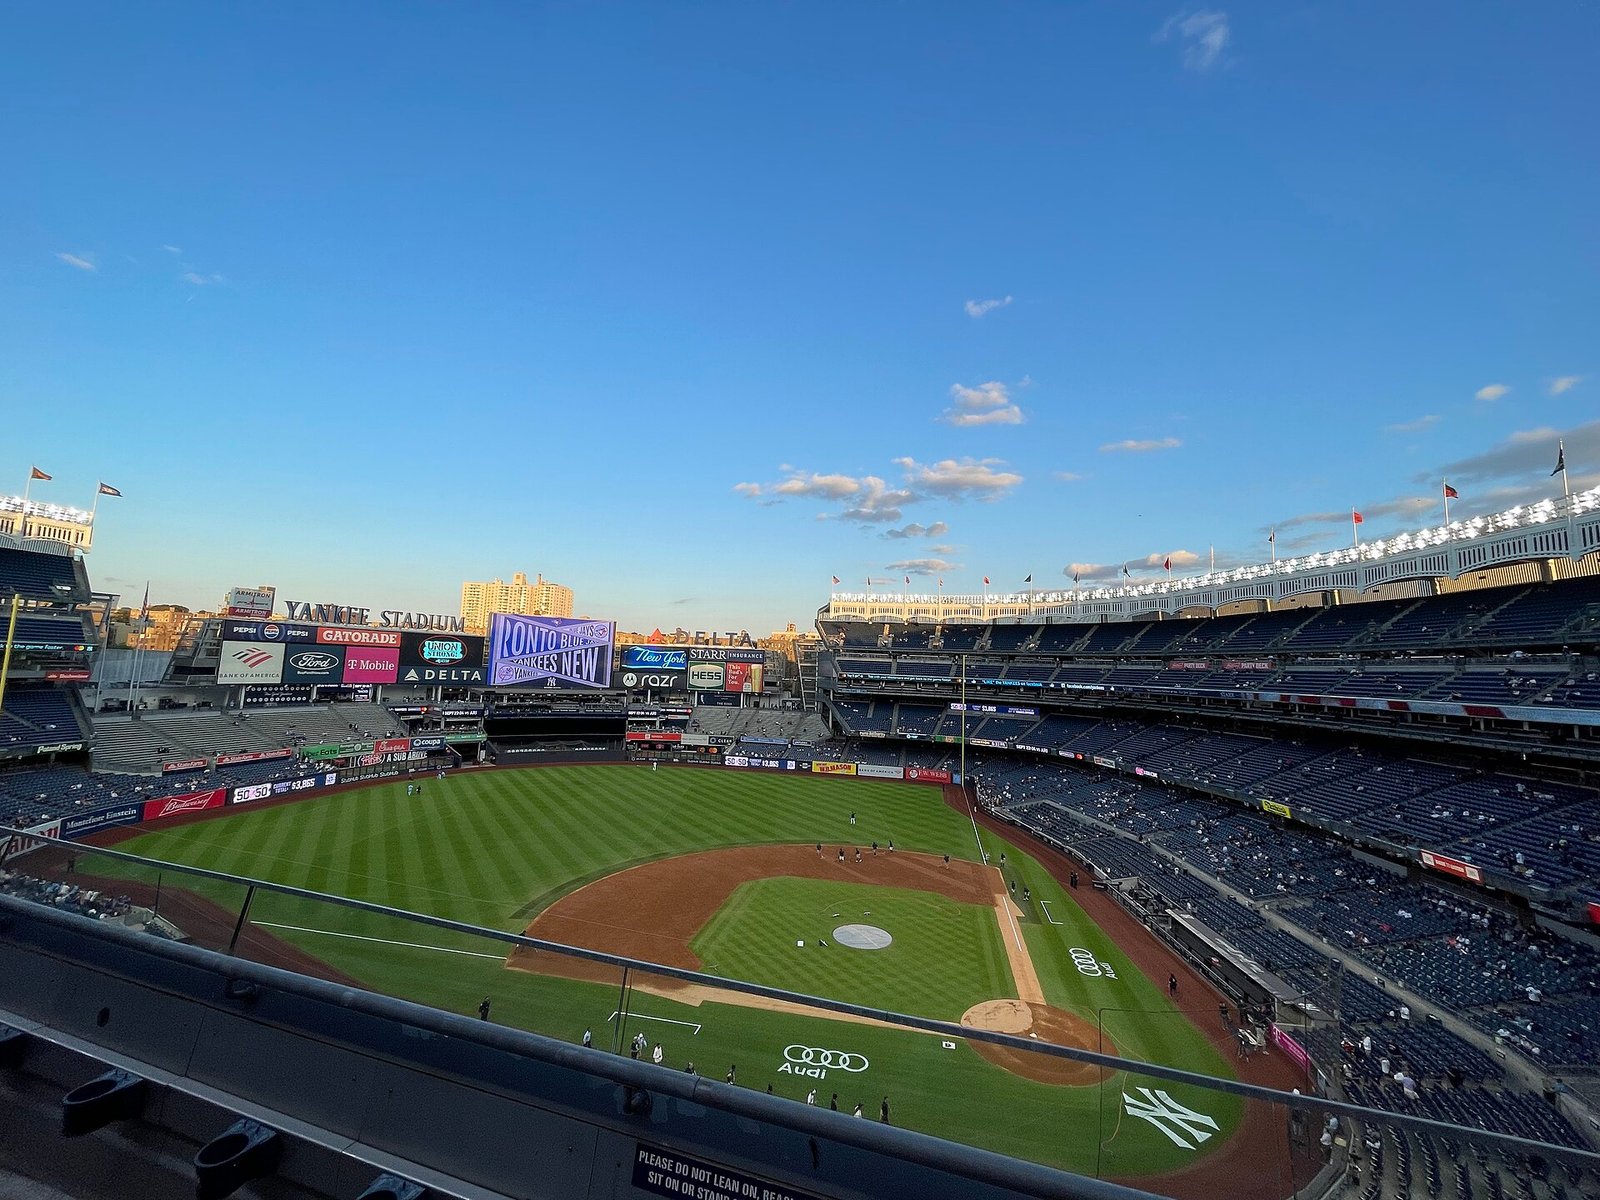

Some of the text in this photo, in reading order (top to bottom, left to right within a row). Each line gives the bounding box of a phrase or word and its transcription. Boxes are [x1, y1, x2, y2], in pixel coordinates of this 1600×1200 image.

[236, 590, 271, 598] ARMITRON
[284, 600, 466, 633] YANKEE STADIUM
[233, 626, 257, 634] PEPSI
[322, 630, 397, 644] GATORADE
[560, 634, 584, 649] BLUE
[675, 629, 754, 647] DELTA
[427, 642, 458, 651] UNION
[298, 654, 331, 667] Ford
[636, 649, 687, 668] New York
[690, 649, 727, 659] STARR
[359, 660, 395, 670] Mobile
[513, 647, 599, 682] YANKEES NEW
[425, 670, 481, 681] DELTA
[641, 675, 678, 687] razr
[692, 671, 722, 680] HESS
[421, 738, 441, 746] coupa
[386, 754, 392, 763] A
[392, 752, 407, 762] SUB
[236, 786, 268, 801] 50 50
[166, 799, 208, 811] Budweiser
[66, 808, 137, 829] Montefiore Einstein
[777, 1062, 827, 1079] Audi
[639, 1150, 674, 1172] PLEASE
[675, 1162, 689, 1176] DO
[691, 1166, 712, 1183] NOT
[713, 1173, 740, 1193] LEAN
[742, 1183, 760, 1200] ON,
[648, 1171, 664, 1186] SIT
[665, 1176, 679, 1192] ON
[681, 1182, 695, 1197] OR
